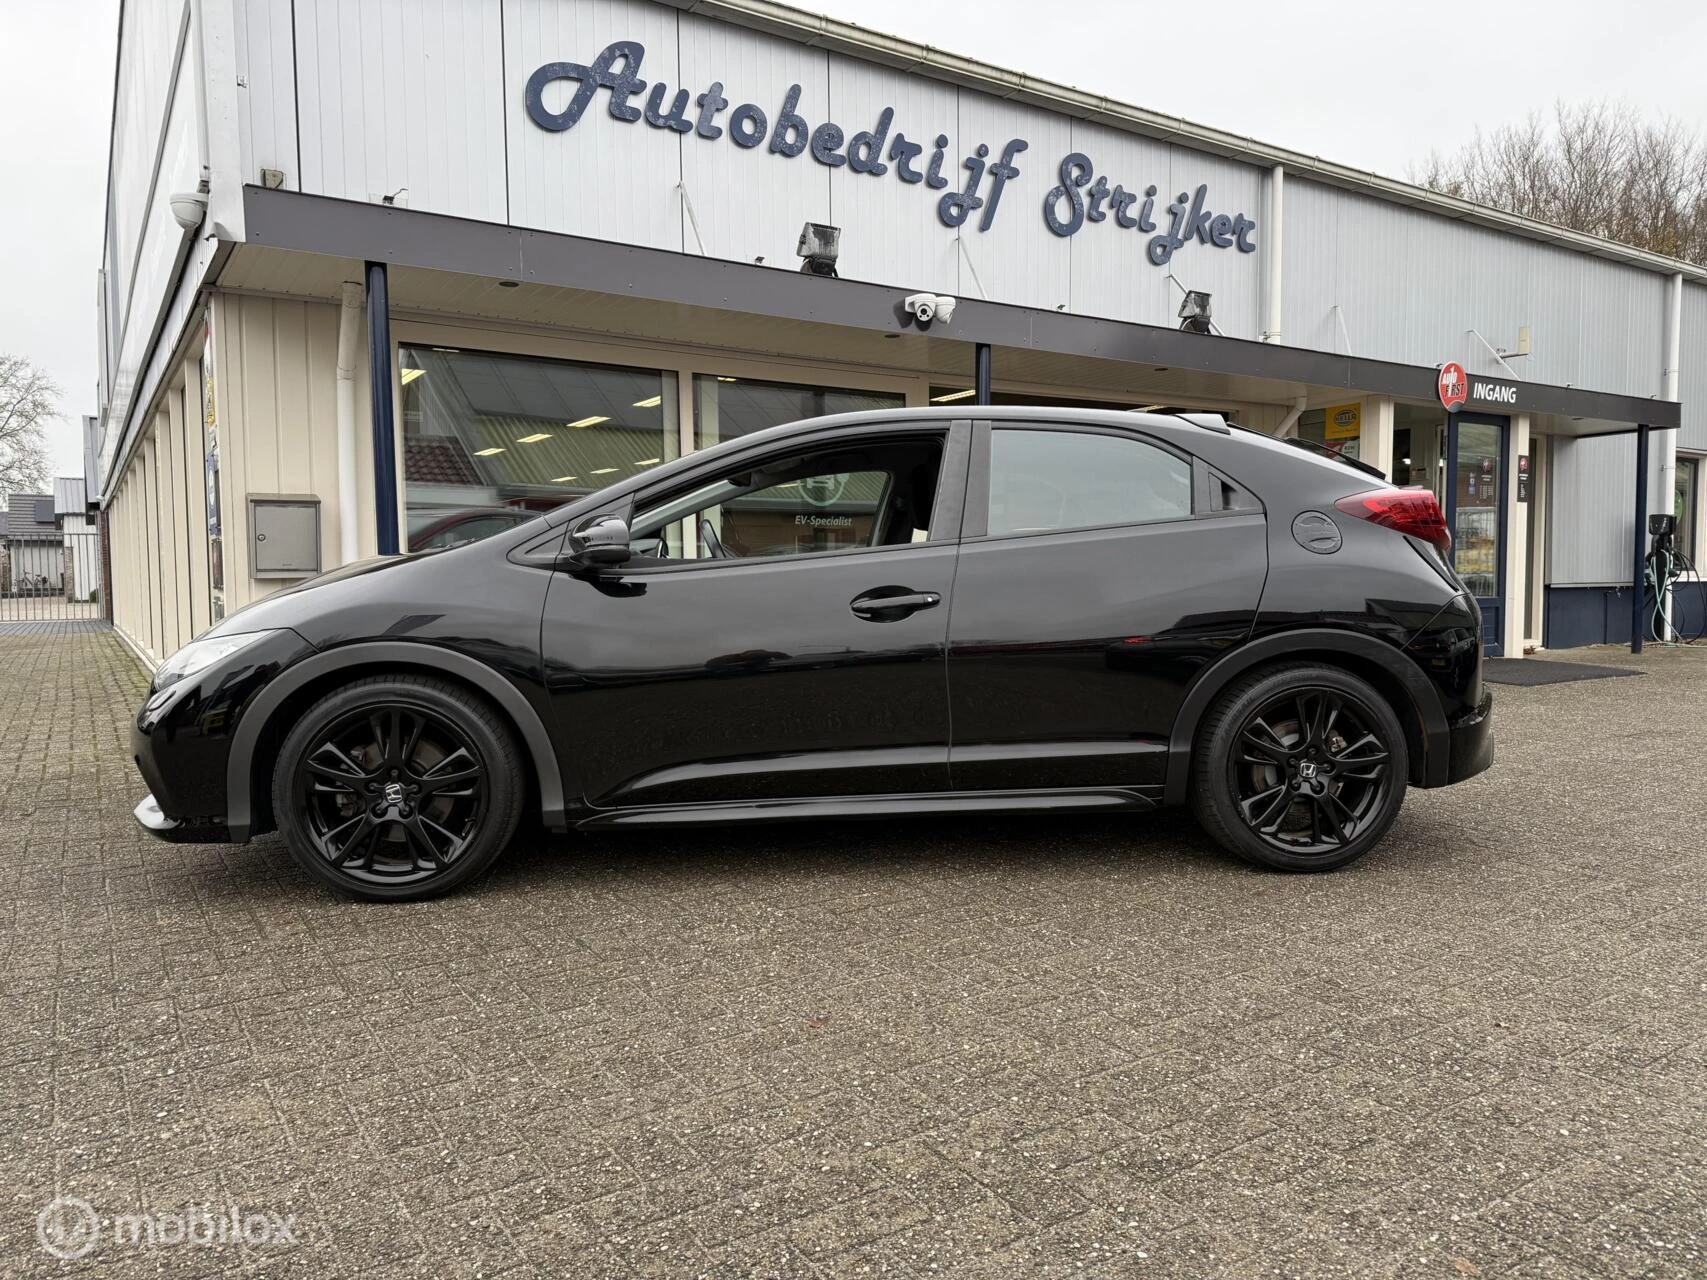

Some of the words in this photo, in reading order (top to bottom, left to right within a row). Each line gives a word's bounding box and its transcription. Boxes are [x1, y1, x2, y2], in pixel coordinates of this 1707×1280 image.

[525, 41, 1029, 232] Autobedrijf
[1043, 152, 1257, 265] Strijker
[1473, 382, 1517, 403] INGANG
[795, 515, 852, 527] EV-Specialist
